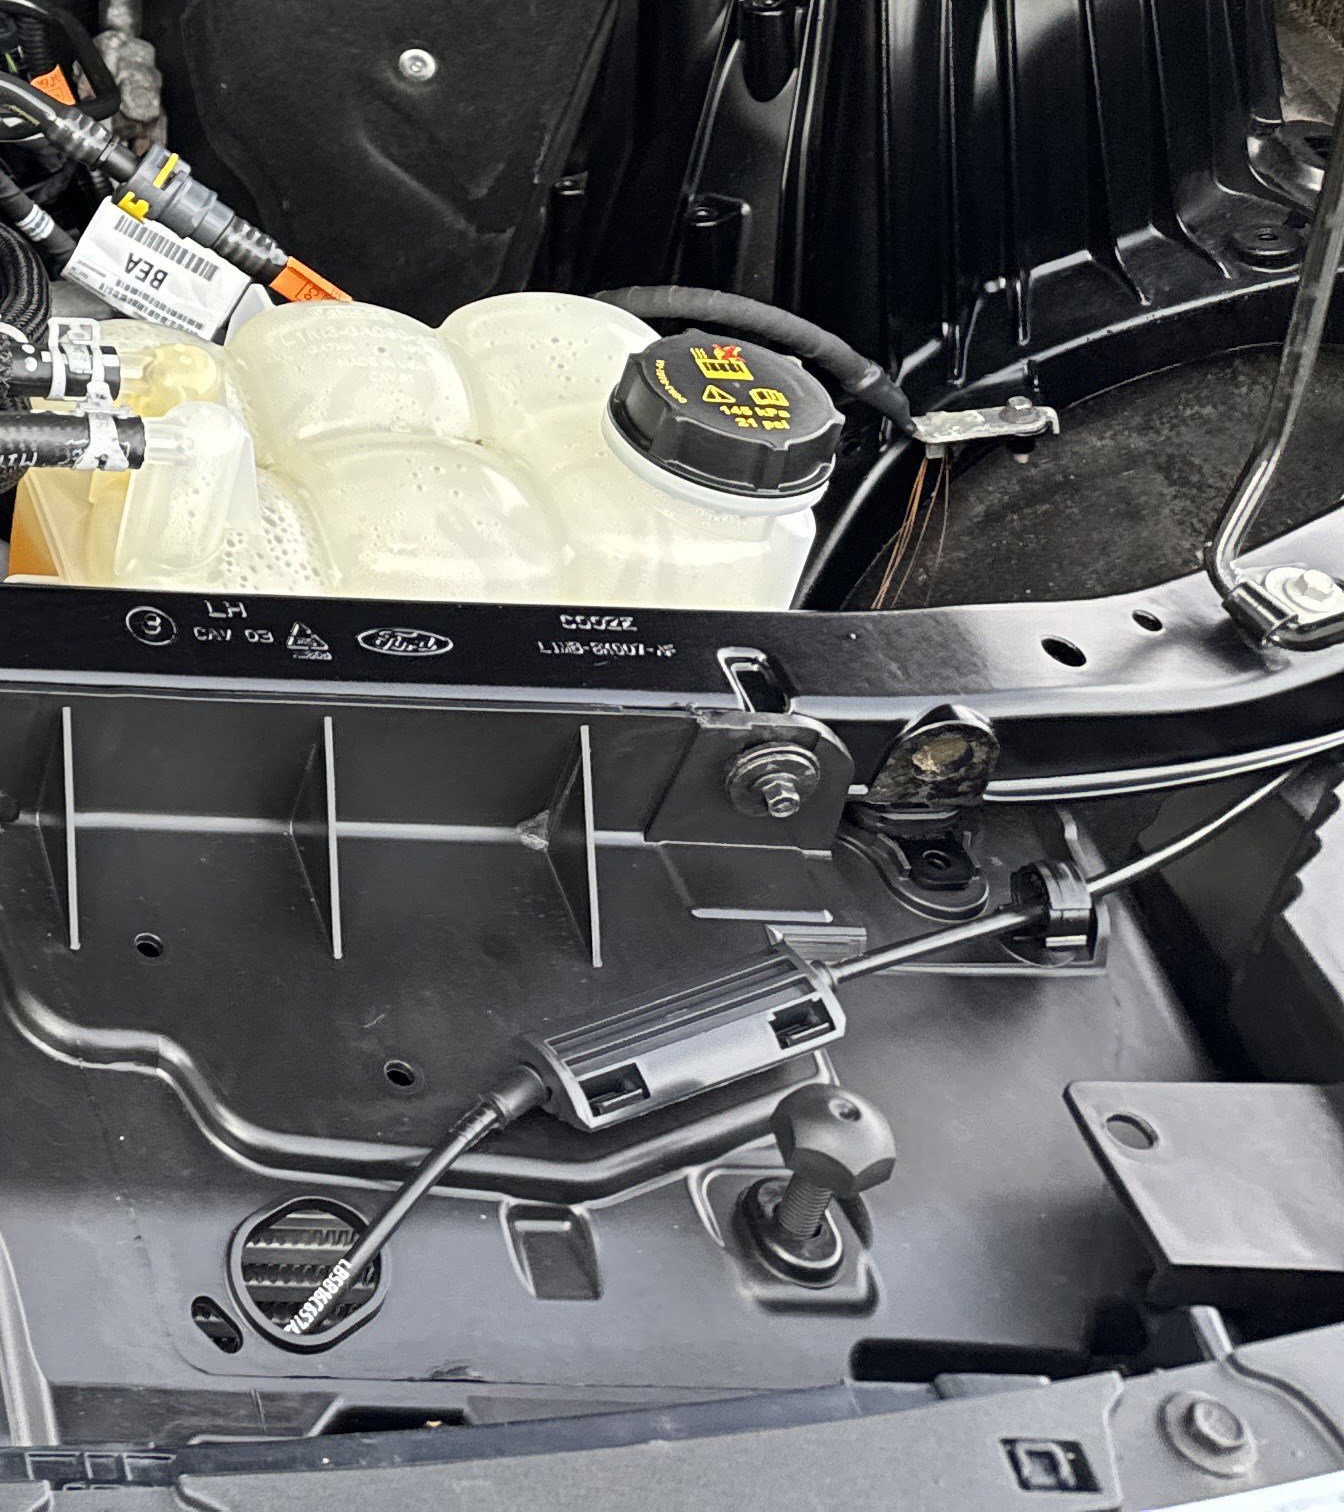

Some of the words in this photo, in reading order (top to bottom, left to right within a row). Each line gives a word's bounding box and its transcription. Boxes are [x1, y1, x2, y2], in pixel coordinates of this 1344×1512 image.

[124, 252, 168, 291] BEA
[735, 417, 759, 428] 21
[762, 419, 791, 431] psi
[205, 600, 247, 619] LH
